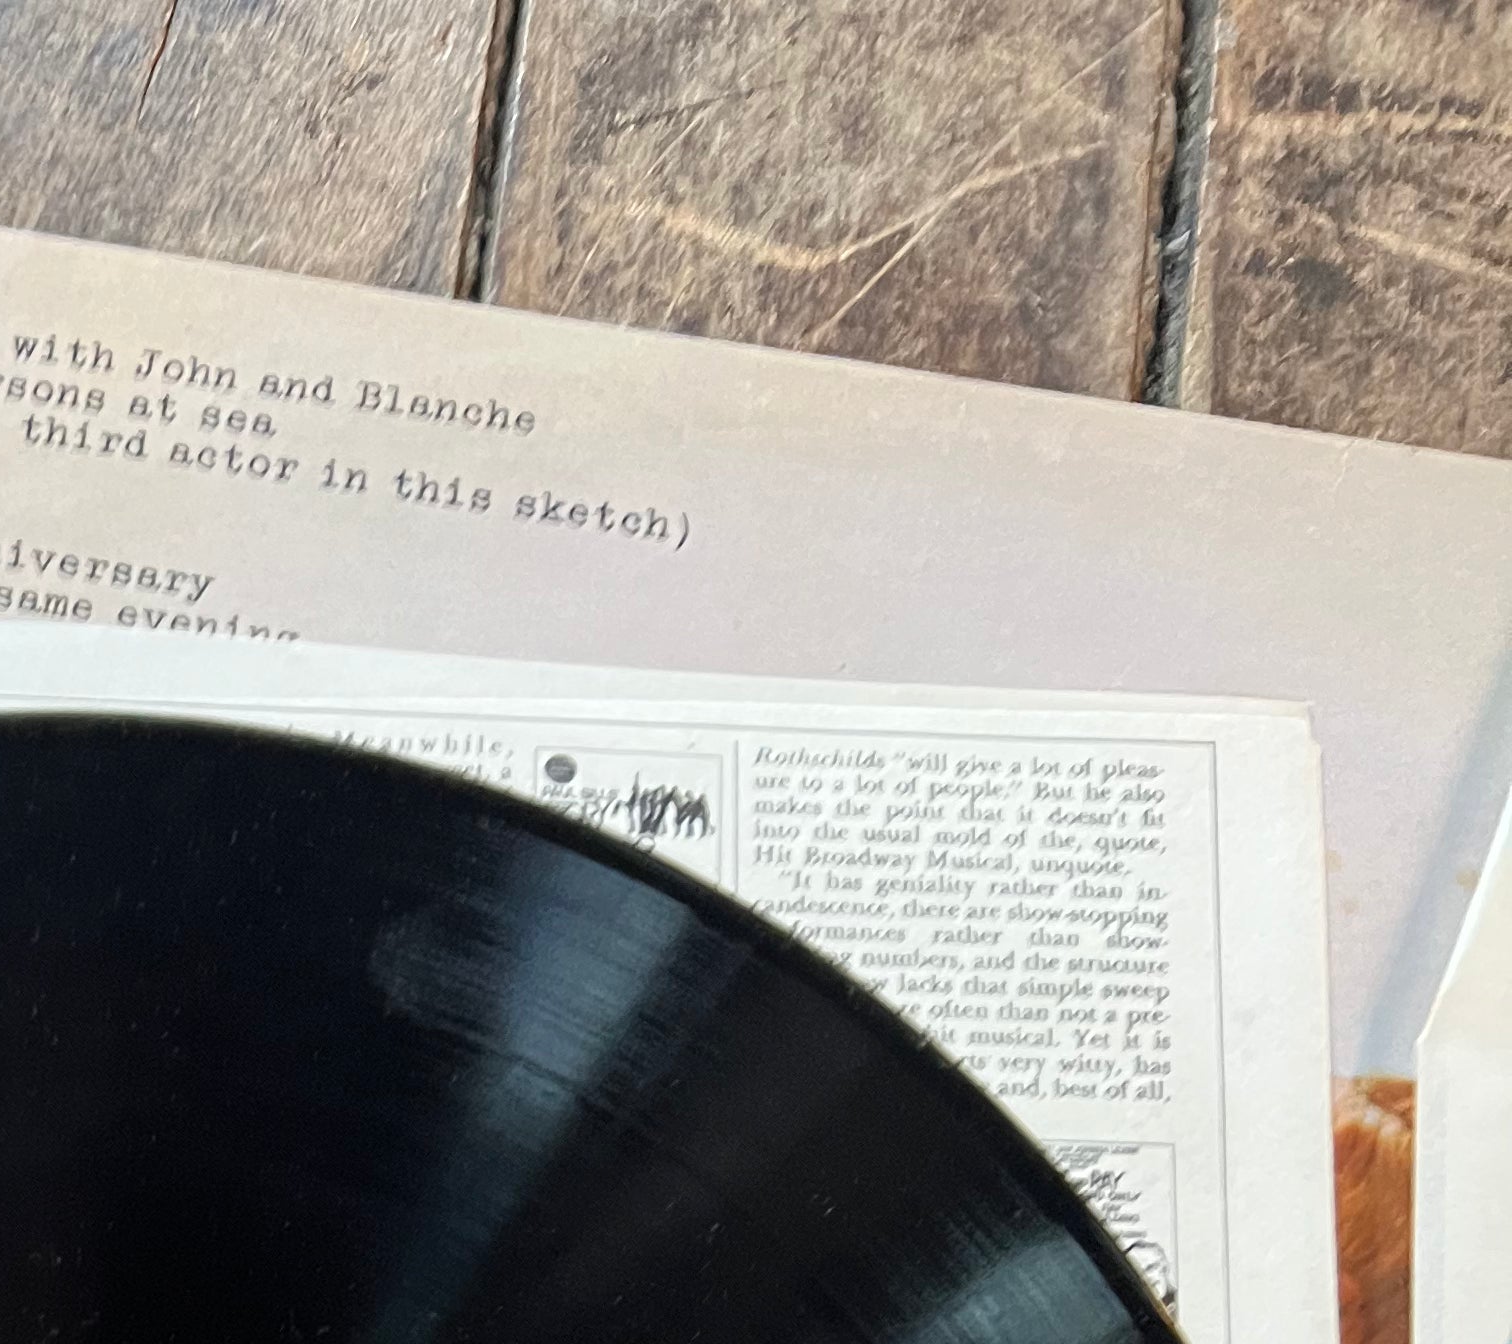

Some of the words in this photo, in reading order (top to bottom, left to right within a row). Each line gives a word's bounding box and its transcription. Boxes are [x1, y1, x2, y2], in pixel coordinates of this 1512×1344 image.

[15, 334, 113, 372] with
[136, 349, 235, 390] John
[259, 375, 334, 403] and
[354, 381, 535, 434] Blanche
[128, 394, 176, 423] at
[200, 406, 276, 438] sea
[23, 414, 147, 457] third
[169, 443, 299, 481] actor
[323, 459, 367, 493] in
[395, 469, 491, 512] this
[515, 491, 689, 549] sketch)
